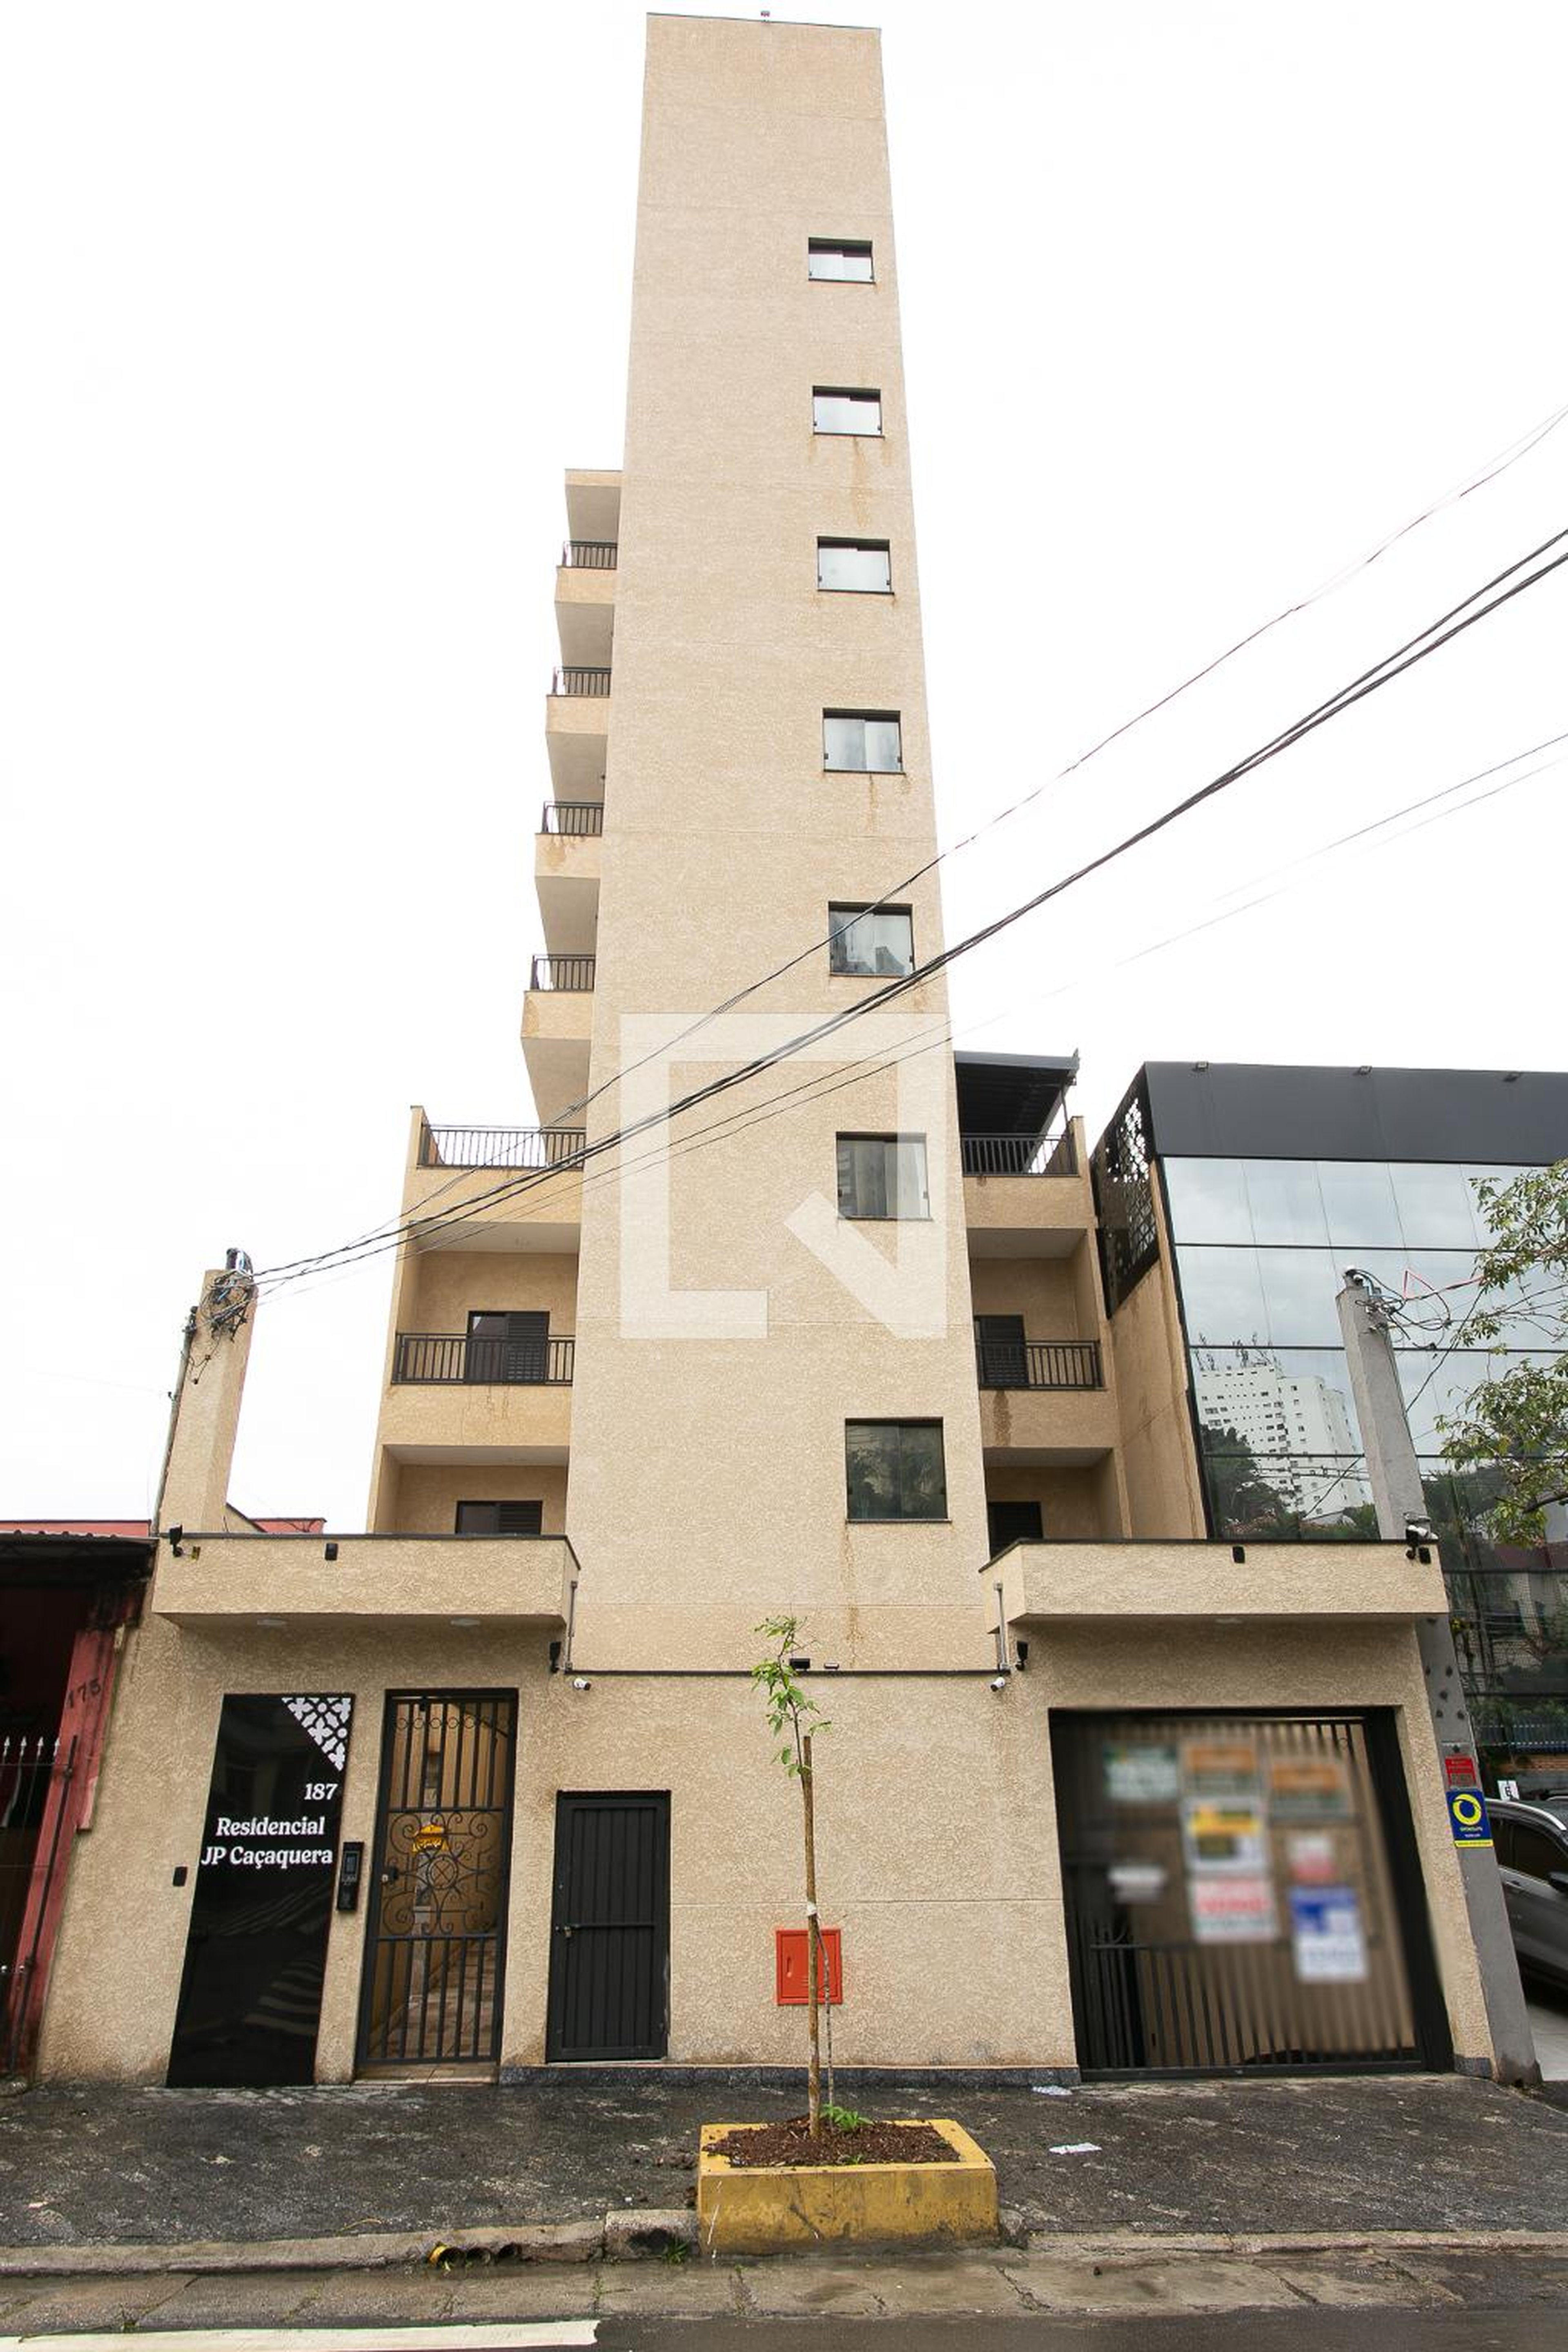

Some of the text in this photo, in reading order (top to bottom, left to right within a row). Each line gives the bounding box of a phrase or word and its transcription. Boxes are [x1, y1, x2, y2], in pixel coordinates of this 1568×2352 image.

[304, 1783, 338, 1800] 187
[216, 1816, 325, 1836] Residencial
[201, 1846, 333, 1869] JP Caçaquera
